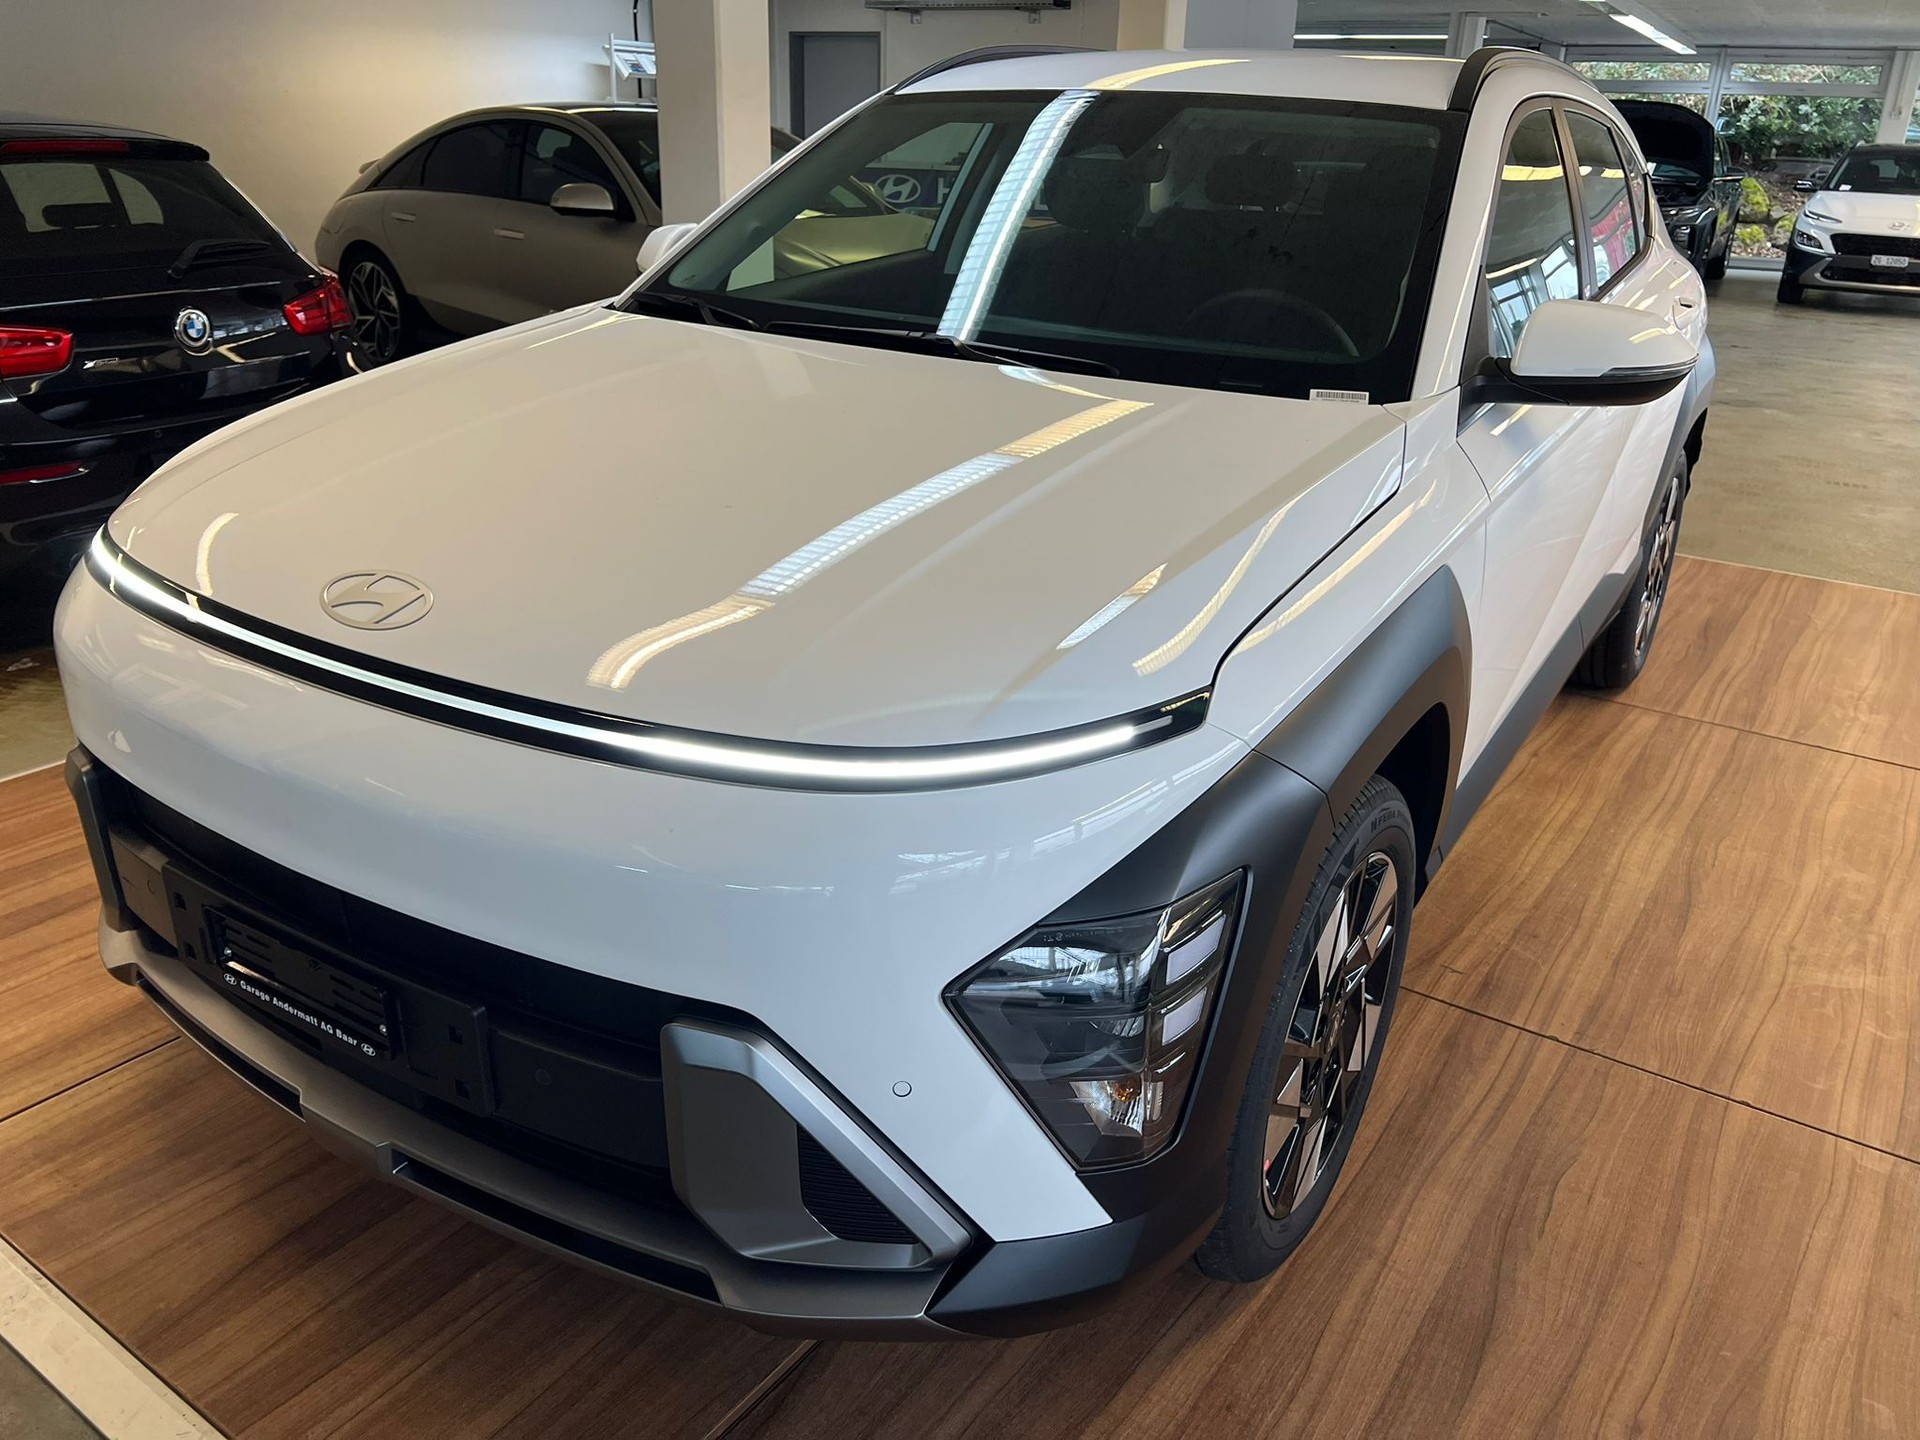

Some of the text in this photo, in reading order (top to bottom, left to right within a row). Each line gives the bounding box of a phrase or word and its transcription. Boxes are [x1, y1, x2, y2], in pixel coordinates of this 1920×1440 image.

[240, 979, 358, 1047] Garage Andermatt AG Baar
